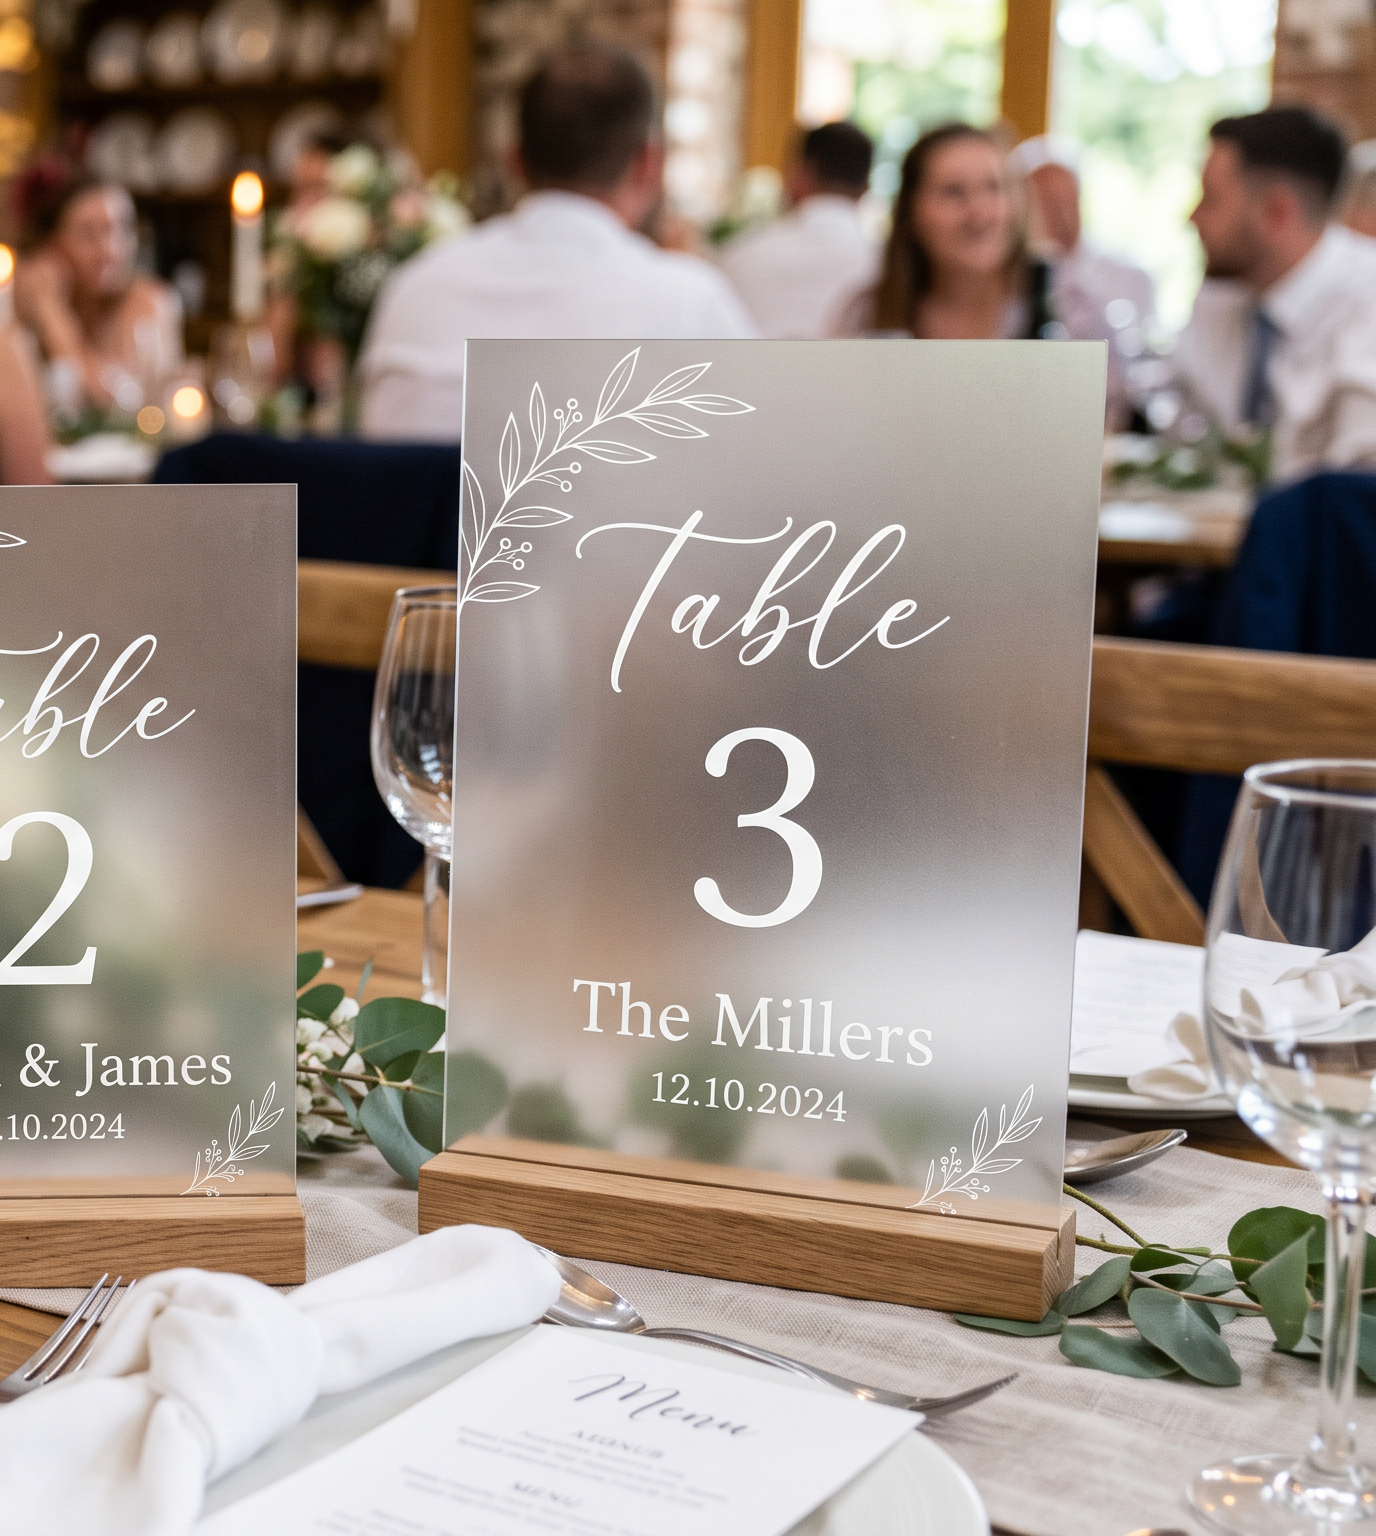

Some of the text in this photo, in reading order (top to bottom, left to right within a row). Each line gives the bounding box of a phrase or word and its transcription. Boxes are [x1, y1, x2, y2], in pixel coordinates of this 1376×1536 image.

[575, 509, 951, 693] Table
[693, 727, 823, 928] 3
[573, 978, 933, 1067] The Millers
[19, 1043, 61, 1088] &
[75, 1042, 232, 1097] James
[652, 1071, 847, 1123] 12.10.2024
[568, 1374, 754, 1436] Menu
